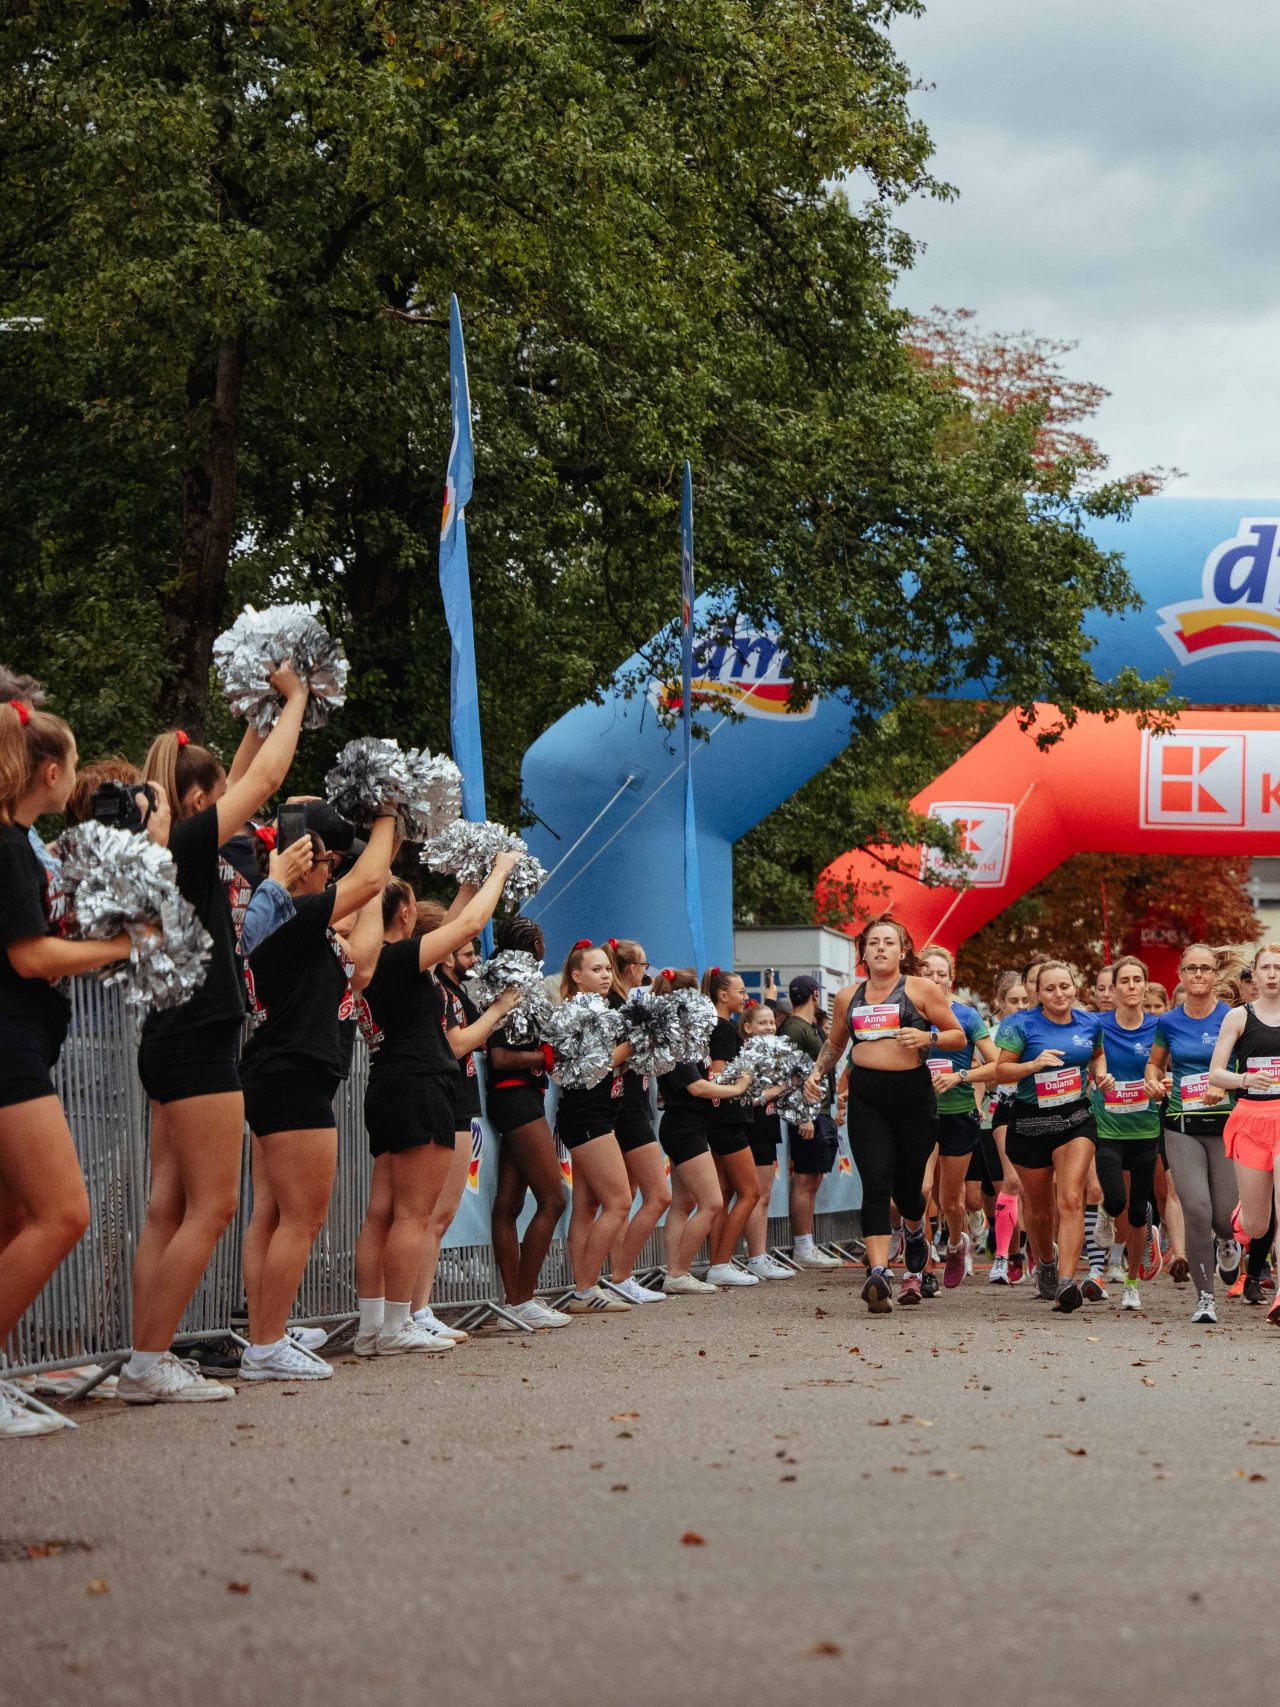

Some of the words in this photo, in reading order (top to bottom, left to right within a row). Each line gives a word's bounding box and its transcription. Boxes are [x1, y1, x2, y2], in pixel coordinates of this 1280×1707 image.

[864, 1015, 887, 1023] Anna
[1045, 1079, 1074, 1091] Daiana
[1116, 1090, 1139, 1099] Anna
